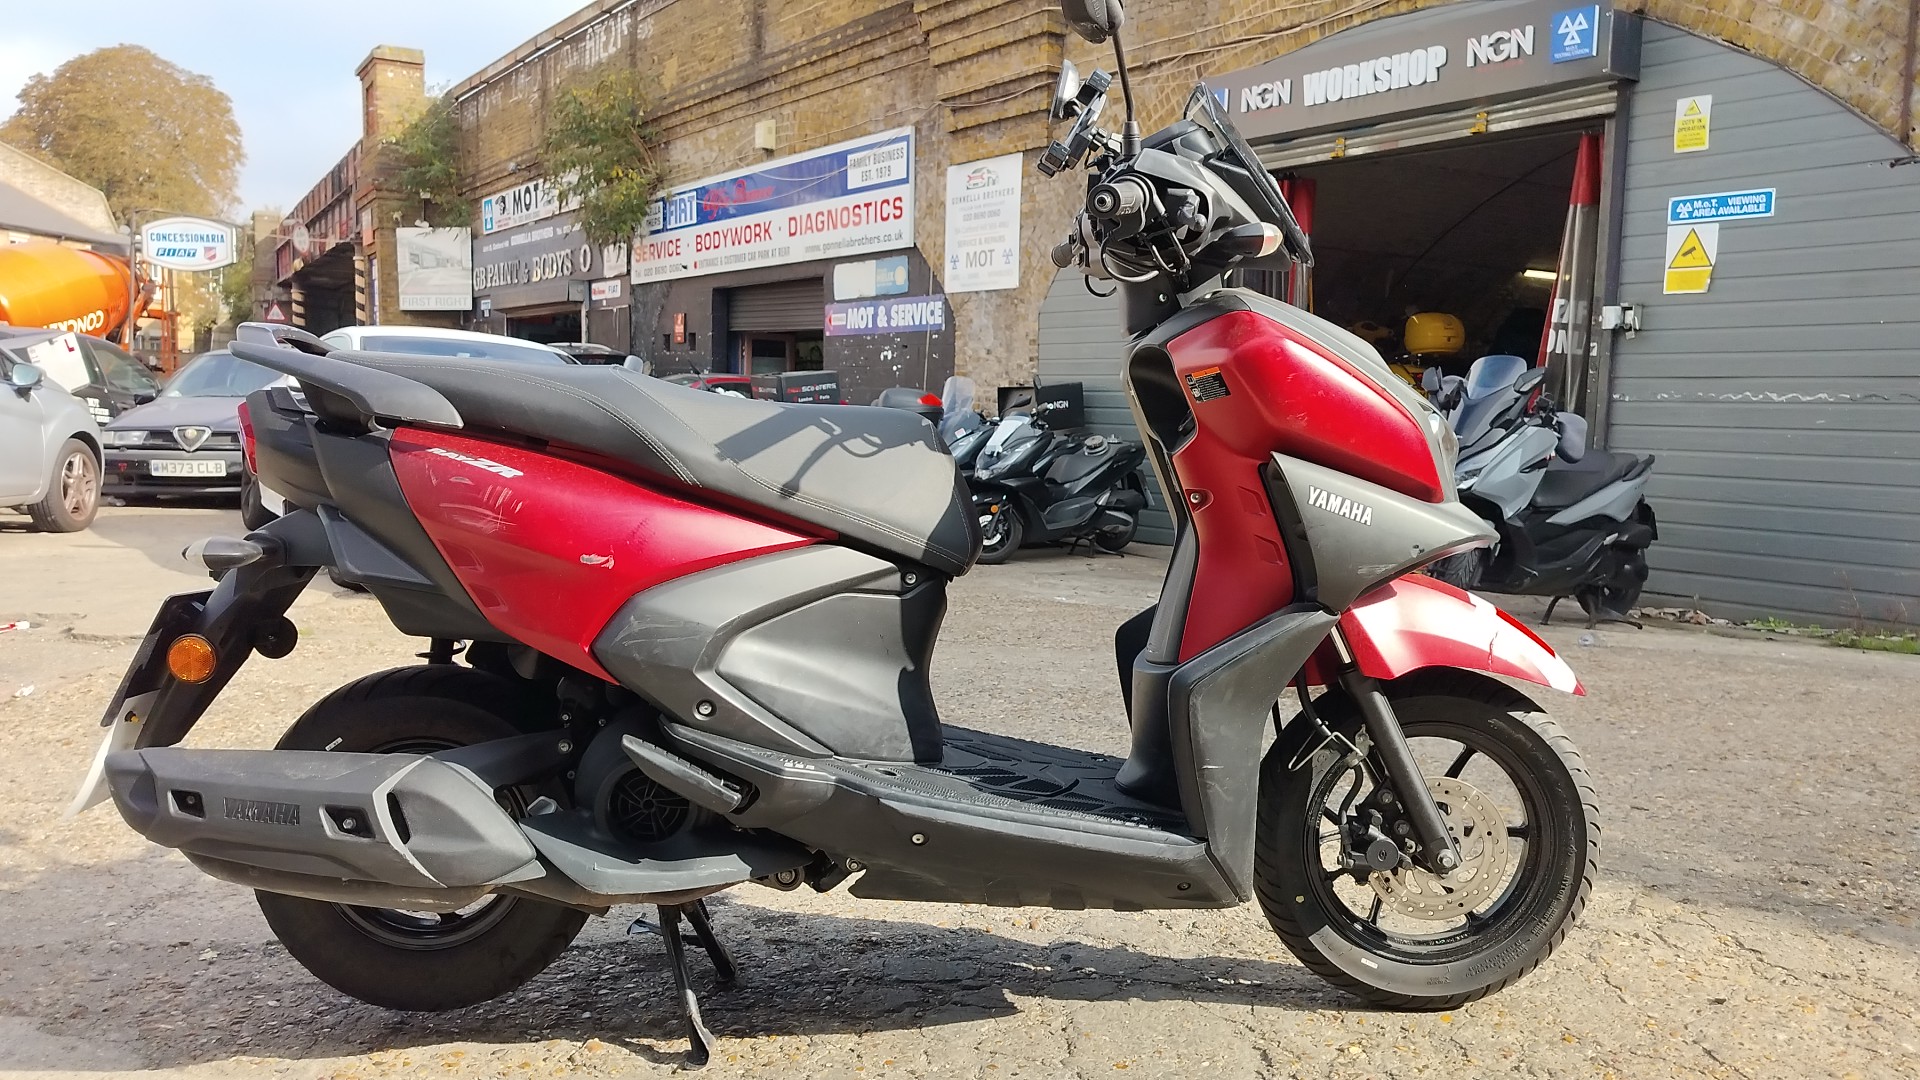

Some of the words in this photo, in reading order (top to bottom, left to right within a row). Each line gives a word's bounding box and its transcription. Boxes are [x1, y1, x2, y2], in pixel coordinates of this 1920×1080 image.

[1467, 25, 1535, 67] NGN
[1240, 79, 1291, 113] NGN
[1303, 45, 1447, 106] WORKSHOP
[873, 146, 905, 165] BUSINESS
[513, 182, 539, 216] MOT
[1727, 194, 1766, 206] VIEWING
[668, 195, 695, 226] FIAT
[1692, 208, 1717, 218] AREA
[1717, 203, 1766, 216] AVAILABLE
[150, 232, 225, 243] CONCESSIONARIA
[634, 238, 681, 263] SERVICE
[695, 221, 772, 253] BODYWORK
[788, 196, 903, 237] DIAGNOSTICS
[156, 247, 197, 257] FIAT
[747, 251, 756, 261] CAR
[757, 249, 770, 260] PARK
[771, 248, 777, 258] AT
[965, 249, 995, 269] MOT
[486, 260, 521, 288] PAINT
[402, 296, 431, 307] FIRST
[435, 296, 469, 307] RIGHT
[846, 306, 874, 329] MOT
[876, 305, 888, 327] &
[890, 301, 942, 327] SERVICE
[64, 339, 75, 352] L
[161, 462, 194, 473] M373
[197, 462, 223, 473] CLB
[1307, 485, 1373, 526] YAMAHA
[223, 797, 300, 826] YAMAHA
